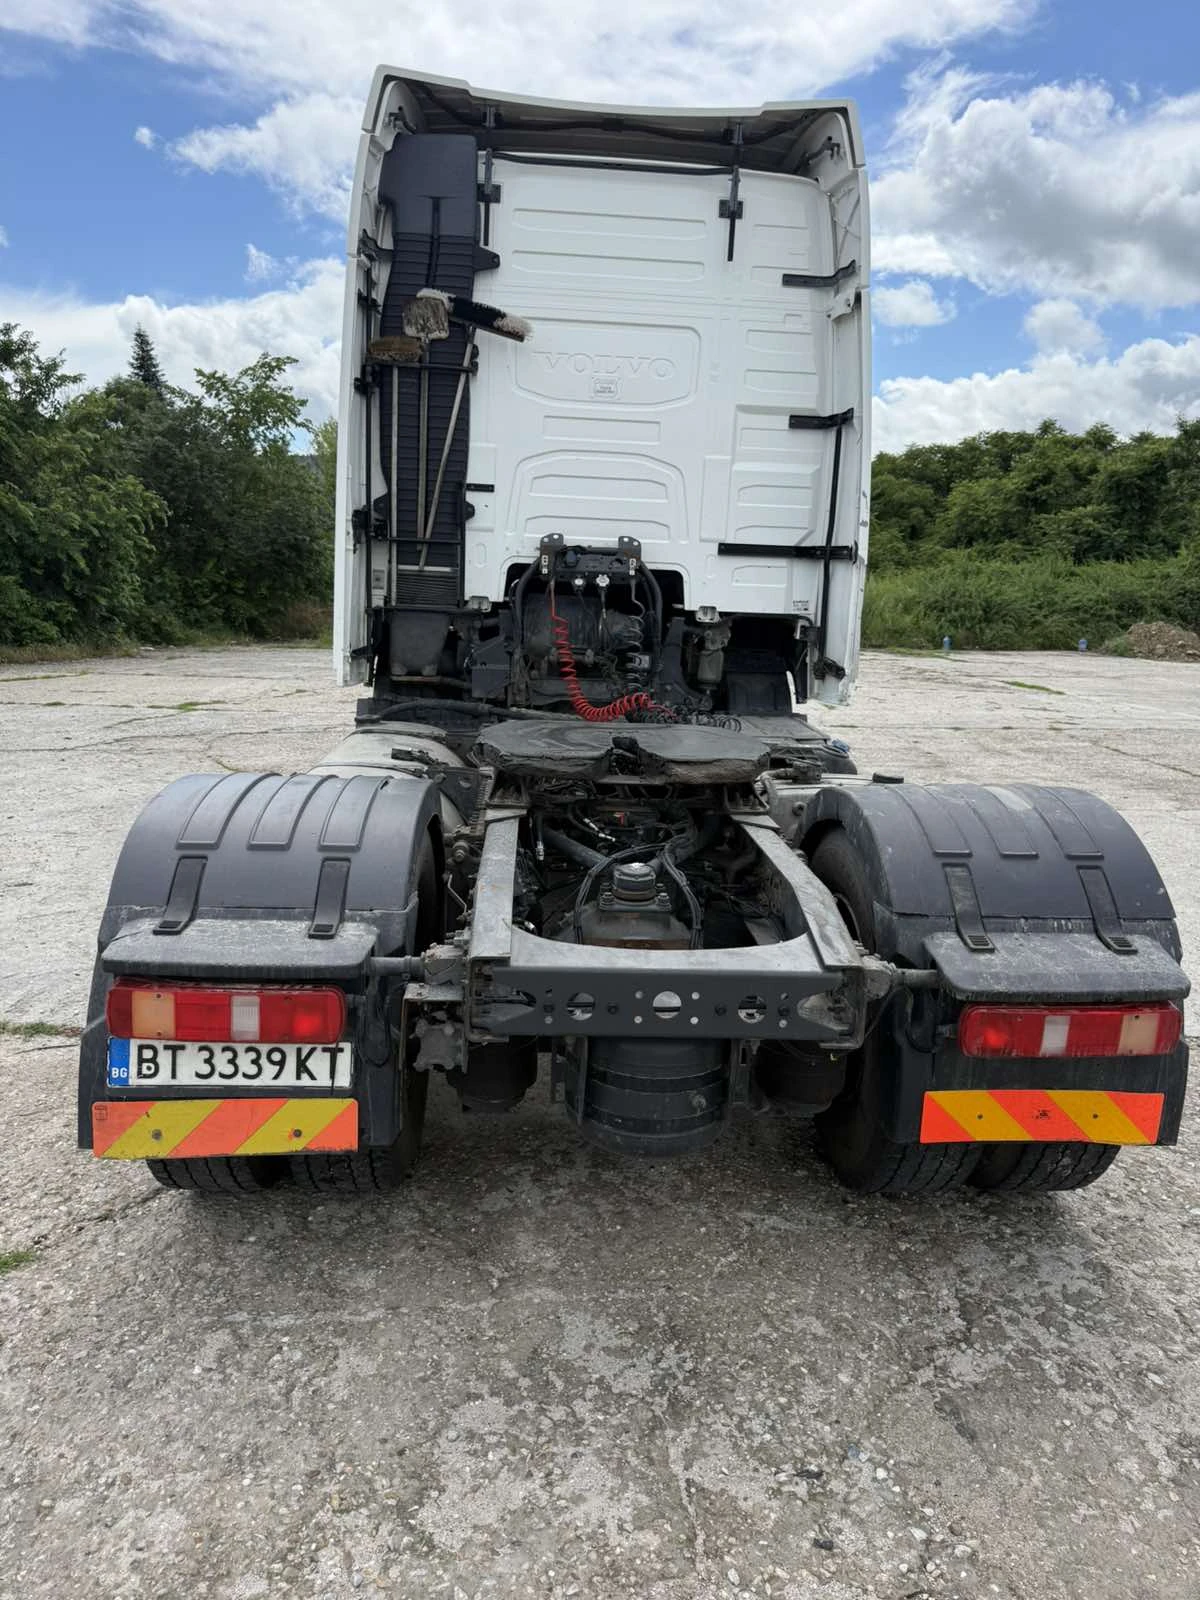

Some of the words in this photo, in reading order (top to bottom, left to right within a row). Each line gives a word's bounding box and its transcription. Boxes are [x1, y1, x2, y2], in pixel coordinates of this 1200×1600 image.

[532, 351, 676, 378] VOLVO
[111, 1067, 128, 1078] BG
[137, 1044, 186, 1080] BT
[194, 1046, 287, 1080] 3339
[295, 1046, 344, 1081] KT
